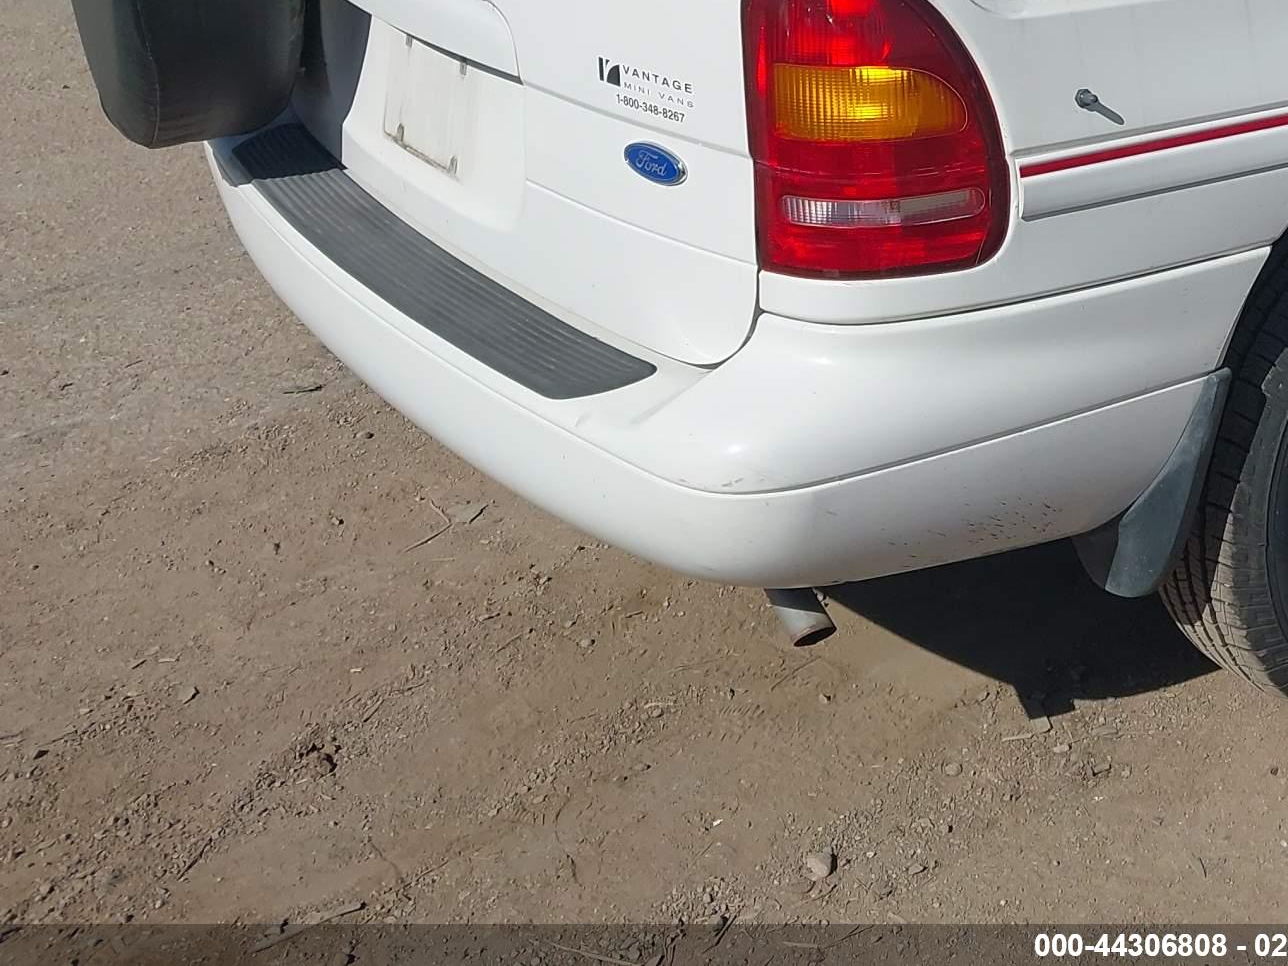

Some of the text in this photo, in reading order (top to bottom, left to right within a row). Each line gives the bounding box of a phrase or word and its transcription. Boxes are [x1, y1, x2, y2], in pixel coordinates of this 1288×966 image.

[622, 64, 693, 94] VANTAGE
[616, 93, 685, 122] 1-800-348-8267
[624, 81, 694, 108] MINI VANS
[635, 149, 667, 176] Ford
